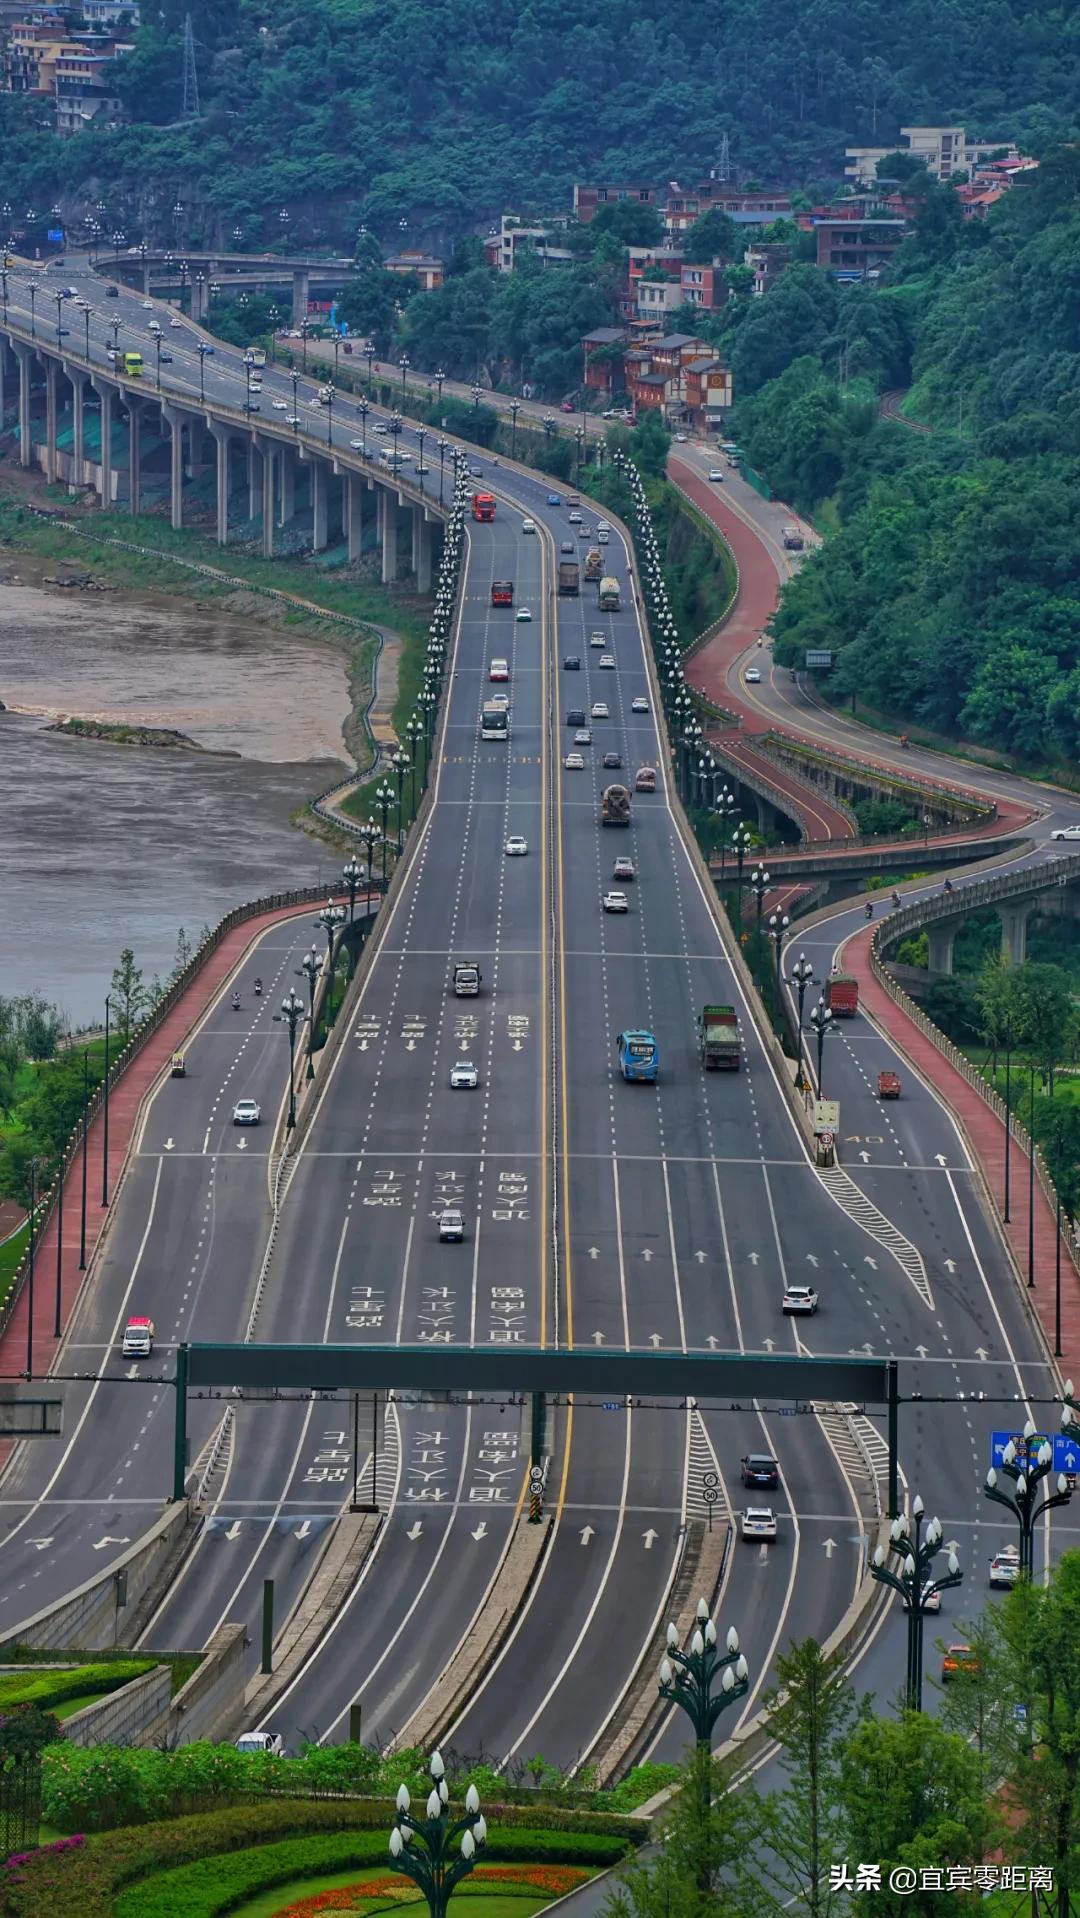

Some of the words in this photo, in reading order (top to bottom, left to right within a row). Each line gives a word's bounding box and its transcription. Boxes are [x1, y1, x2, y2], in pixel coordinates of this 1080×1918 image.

[363, 1170, 406, 1206] 七星路
[428, 1171, 466, 1219] 长江大
[345, 1286, 386, 1327] 七星路
[416, 1287, 457, 1343] 长江大桥
[302, 1431, 351, 1482] 七星路
[404, 1431, 449, 1501] 长江大桥
